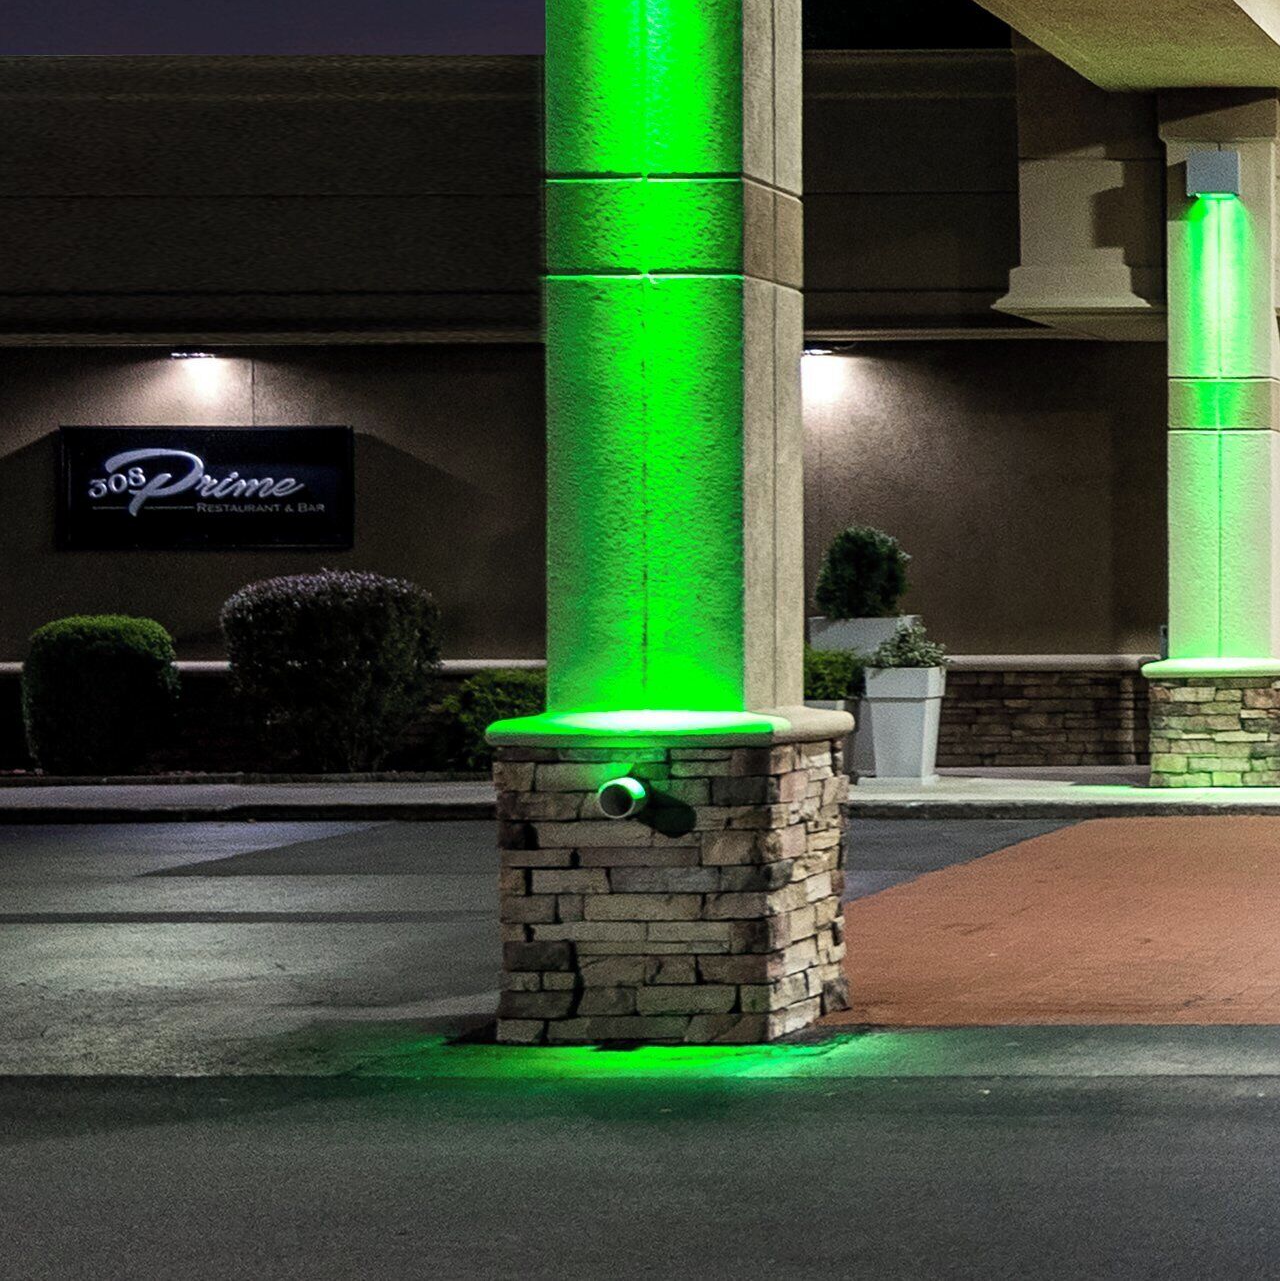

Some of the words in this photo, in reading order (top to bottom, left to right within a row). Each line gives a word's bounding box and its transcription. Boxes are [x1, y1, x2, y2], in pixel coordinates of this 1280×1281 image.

[88, 467, 147, 499] 308
[104, 448, 305, 517] Prime
[284, 503, 294, 513] &
[297, 502, 325, 513] BAR
